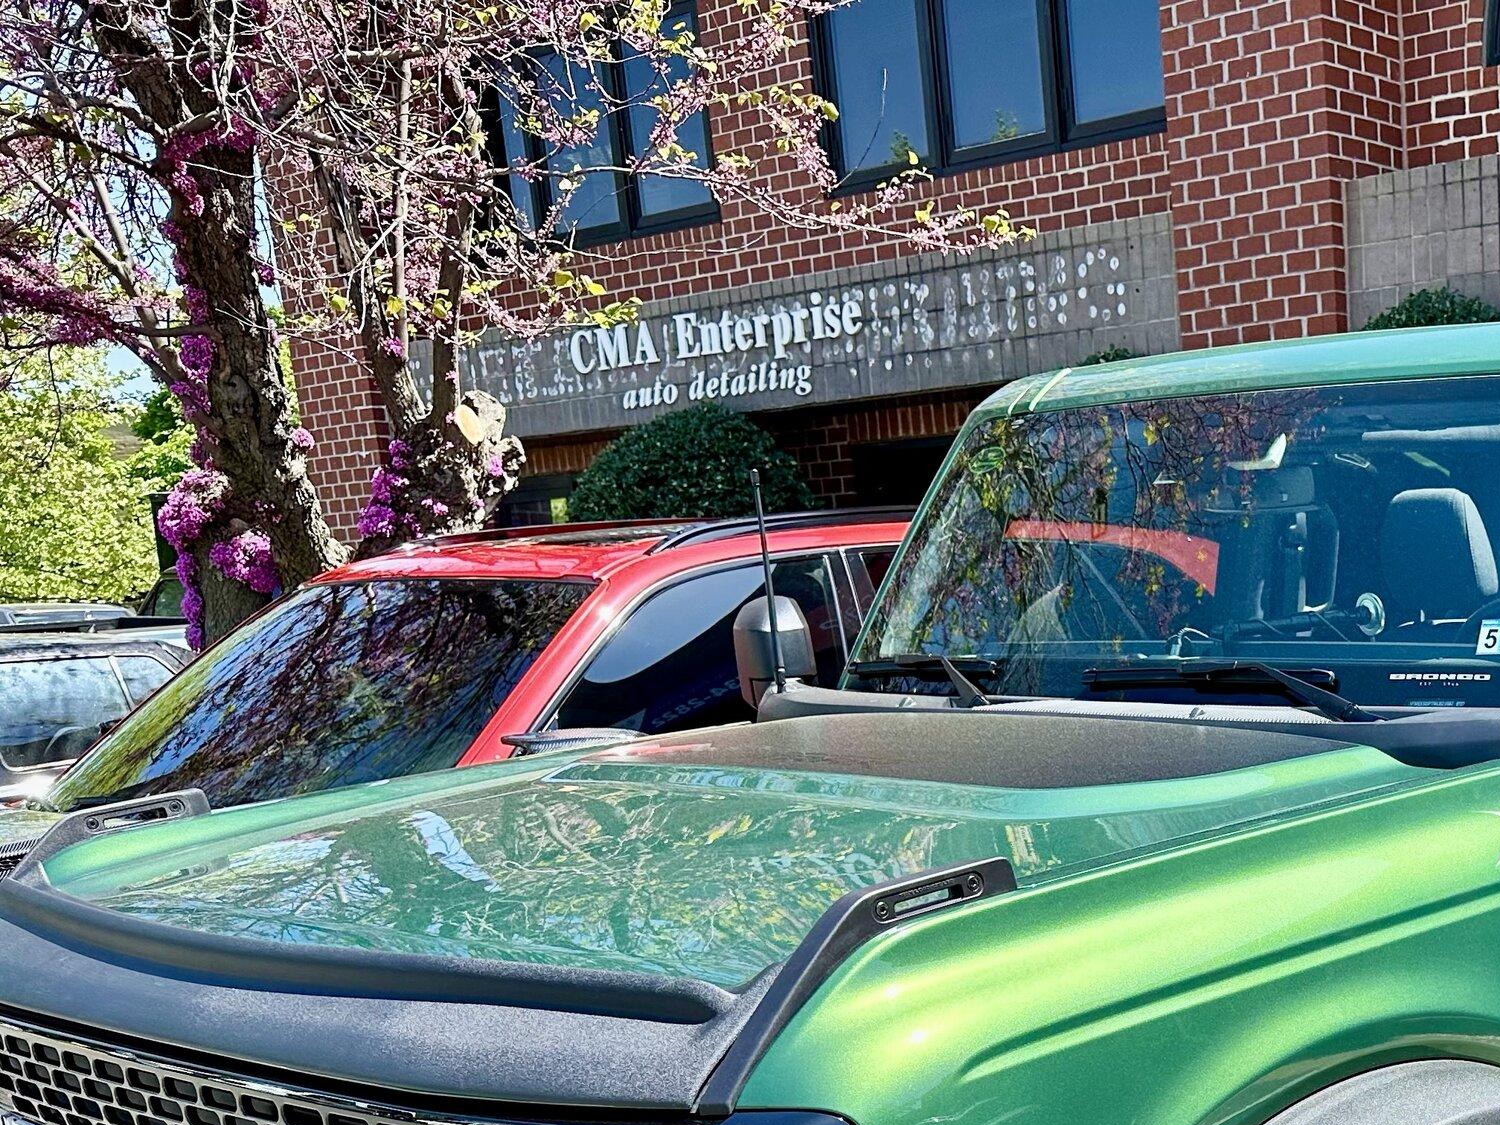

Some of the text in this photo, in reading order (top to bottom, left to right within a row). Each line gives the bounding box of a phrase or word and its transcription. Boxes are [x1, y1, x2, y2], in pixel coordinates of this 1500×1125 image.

[570, 292, 863, 374] CMA Enterprise
[623, 362, 812, 410] auto detailing
[1484, 628, 1499, 649] 5
[1389, 673, 1492, 681] BRONCO
